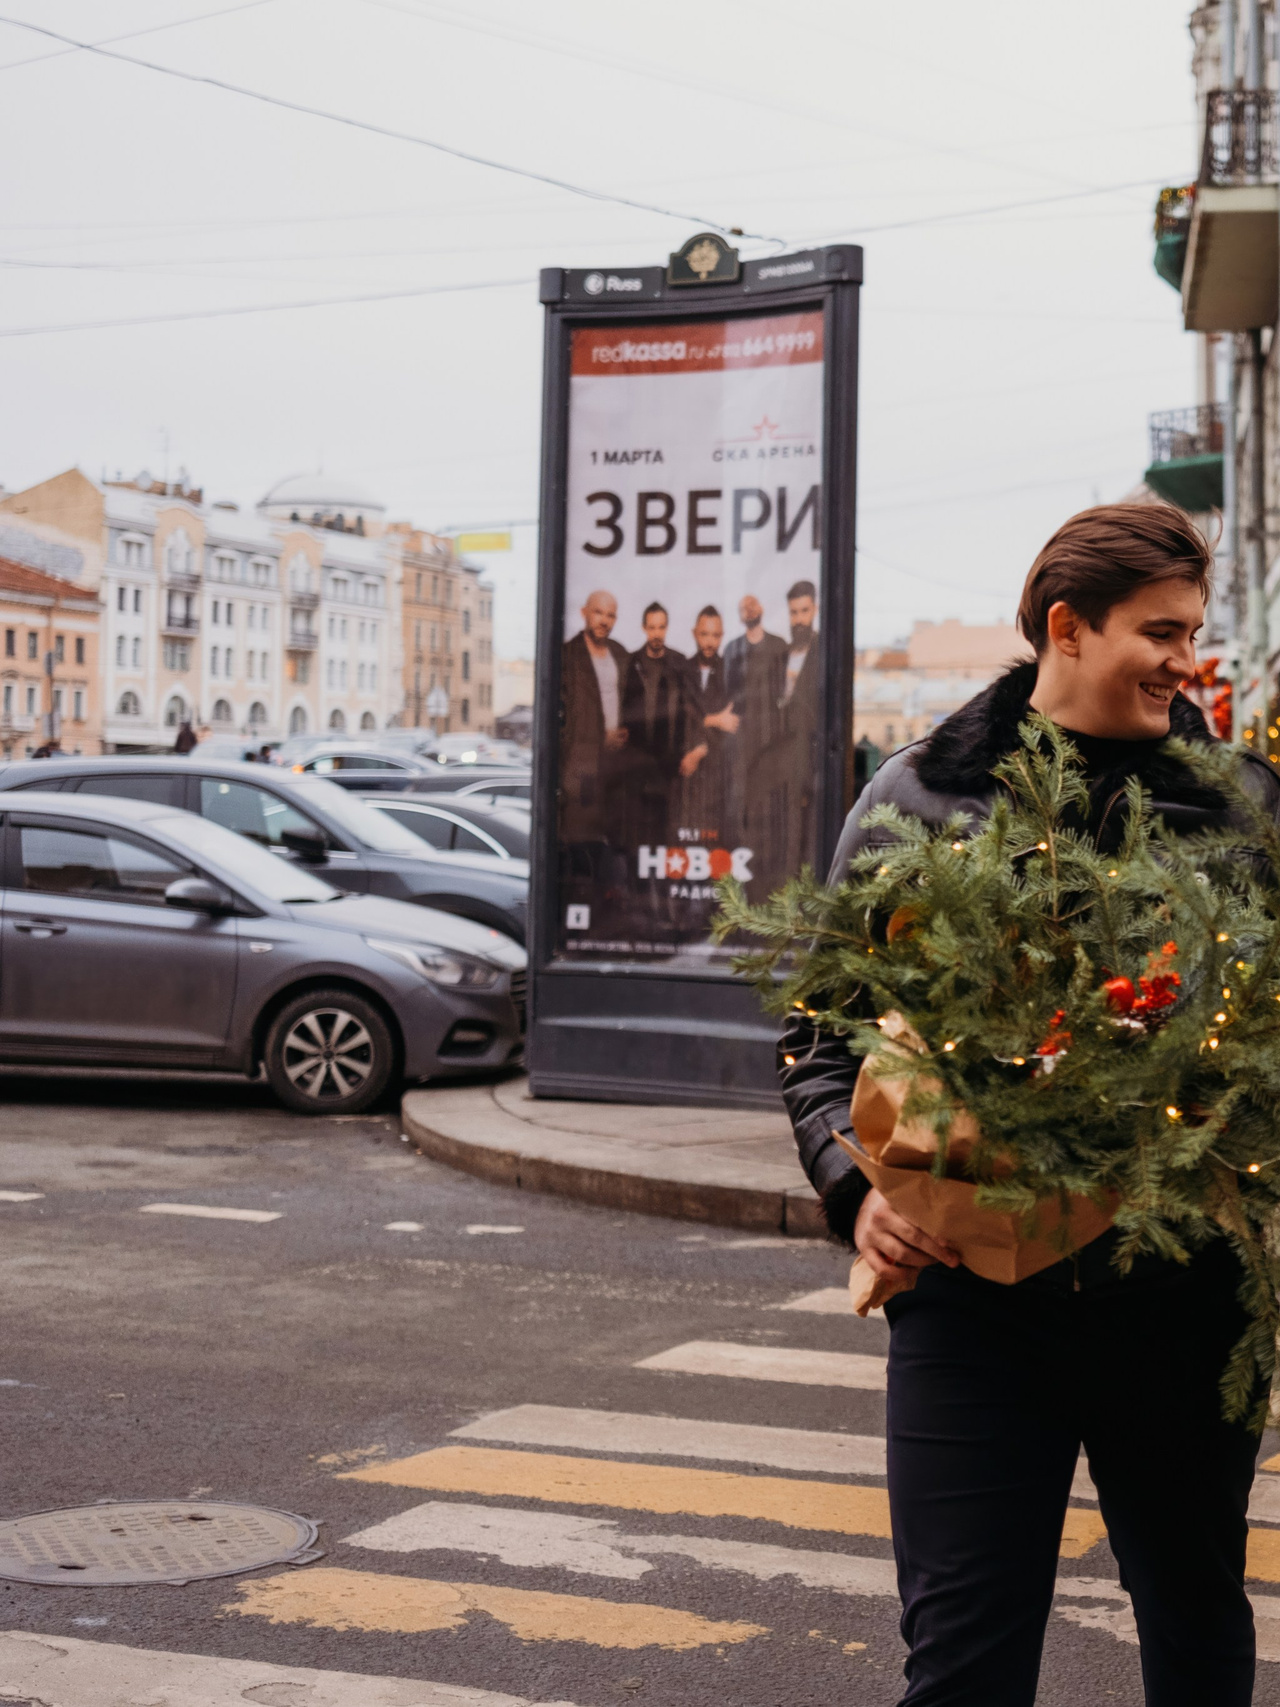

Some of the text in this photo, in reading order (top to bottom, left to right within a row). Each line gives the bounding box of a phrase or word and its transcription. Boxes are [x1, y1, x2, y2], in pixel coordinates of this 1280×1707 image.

[606, 275, 643, 291] Russ
[591, 450, 664, 466] 1 МАРТА
[712, 444, 815, 462] СКА АРЕНА
[582, 484, 822, 558] ЗВЕРИ
